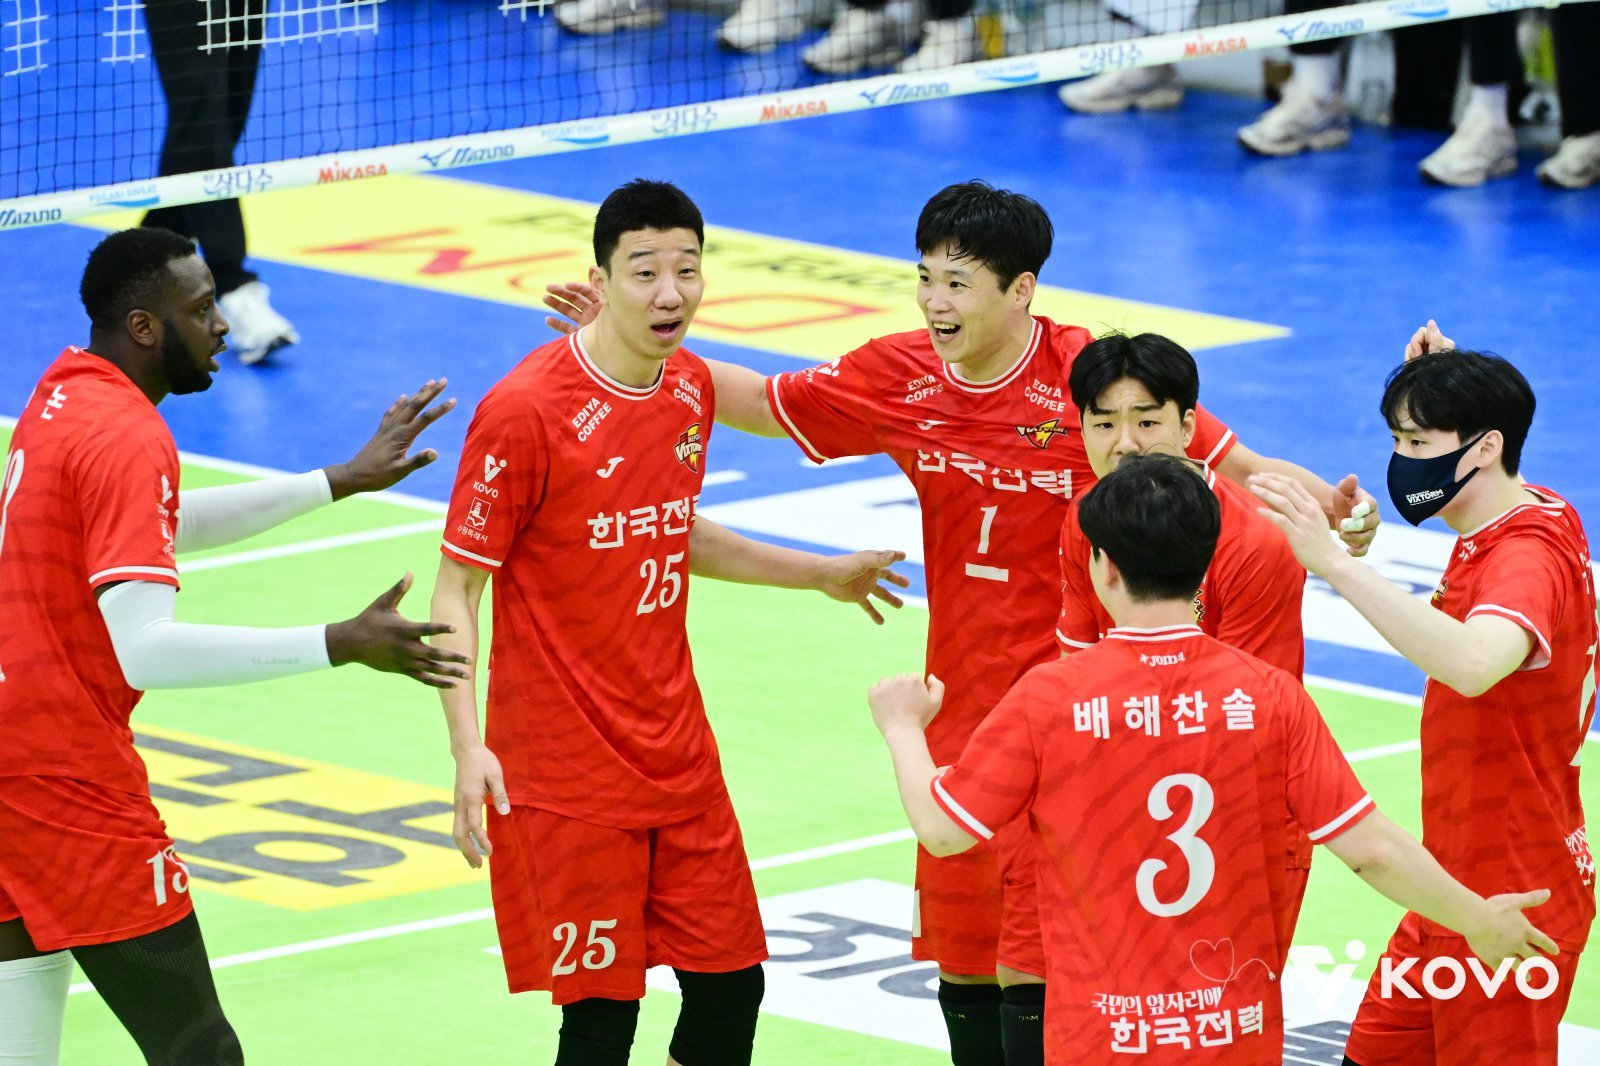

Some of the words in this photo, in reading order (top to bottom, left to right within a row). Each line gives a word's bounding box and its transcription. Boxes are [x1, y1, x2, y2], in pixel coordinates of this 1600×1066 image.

[679, 377, 701, 401] EDIYA
[907, 375, 936, 391] EDIYA
[571, 397, 601, 429] EDIYA
[673, 388, 702, 417] COFFEE
[1024, 386, 1066, 412] COFFEE
[577, 401, 613, 442] COFFEE
[472, 480, 499, 499] KOVO
[1406, 488, 1444, 504] VIXTORM
[976, 505, 998, 554] 1
[636, 550, 685, 617] 25
[1135, 773, 1216, 918] 3
[551, 918, 617, 977] 25
[1091, 992, 1143, 1017] 국민의
[1145, 986, 1223, 1016] 옆자리에
[1110, 1001, 1264, 1054] 한국전력
